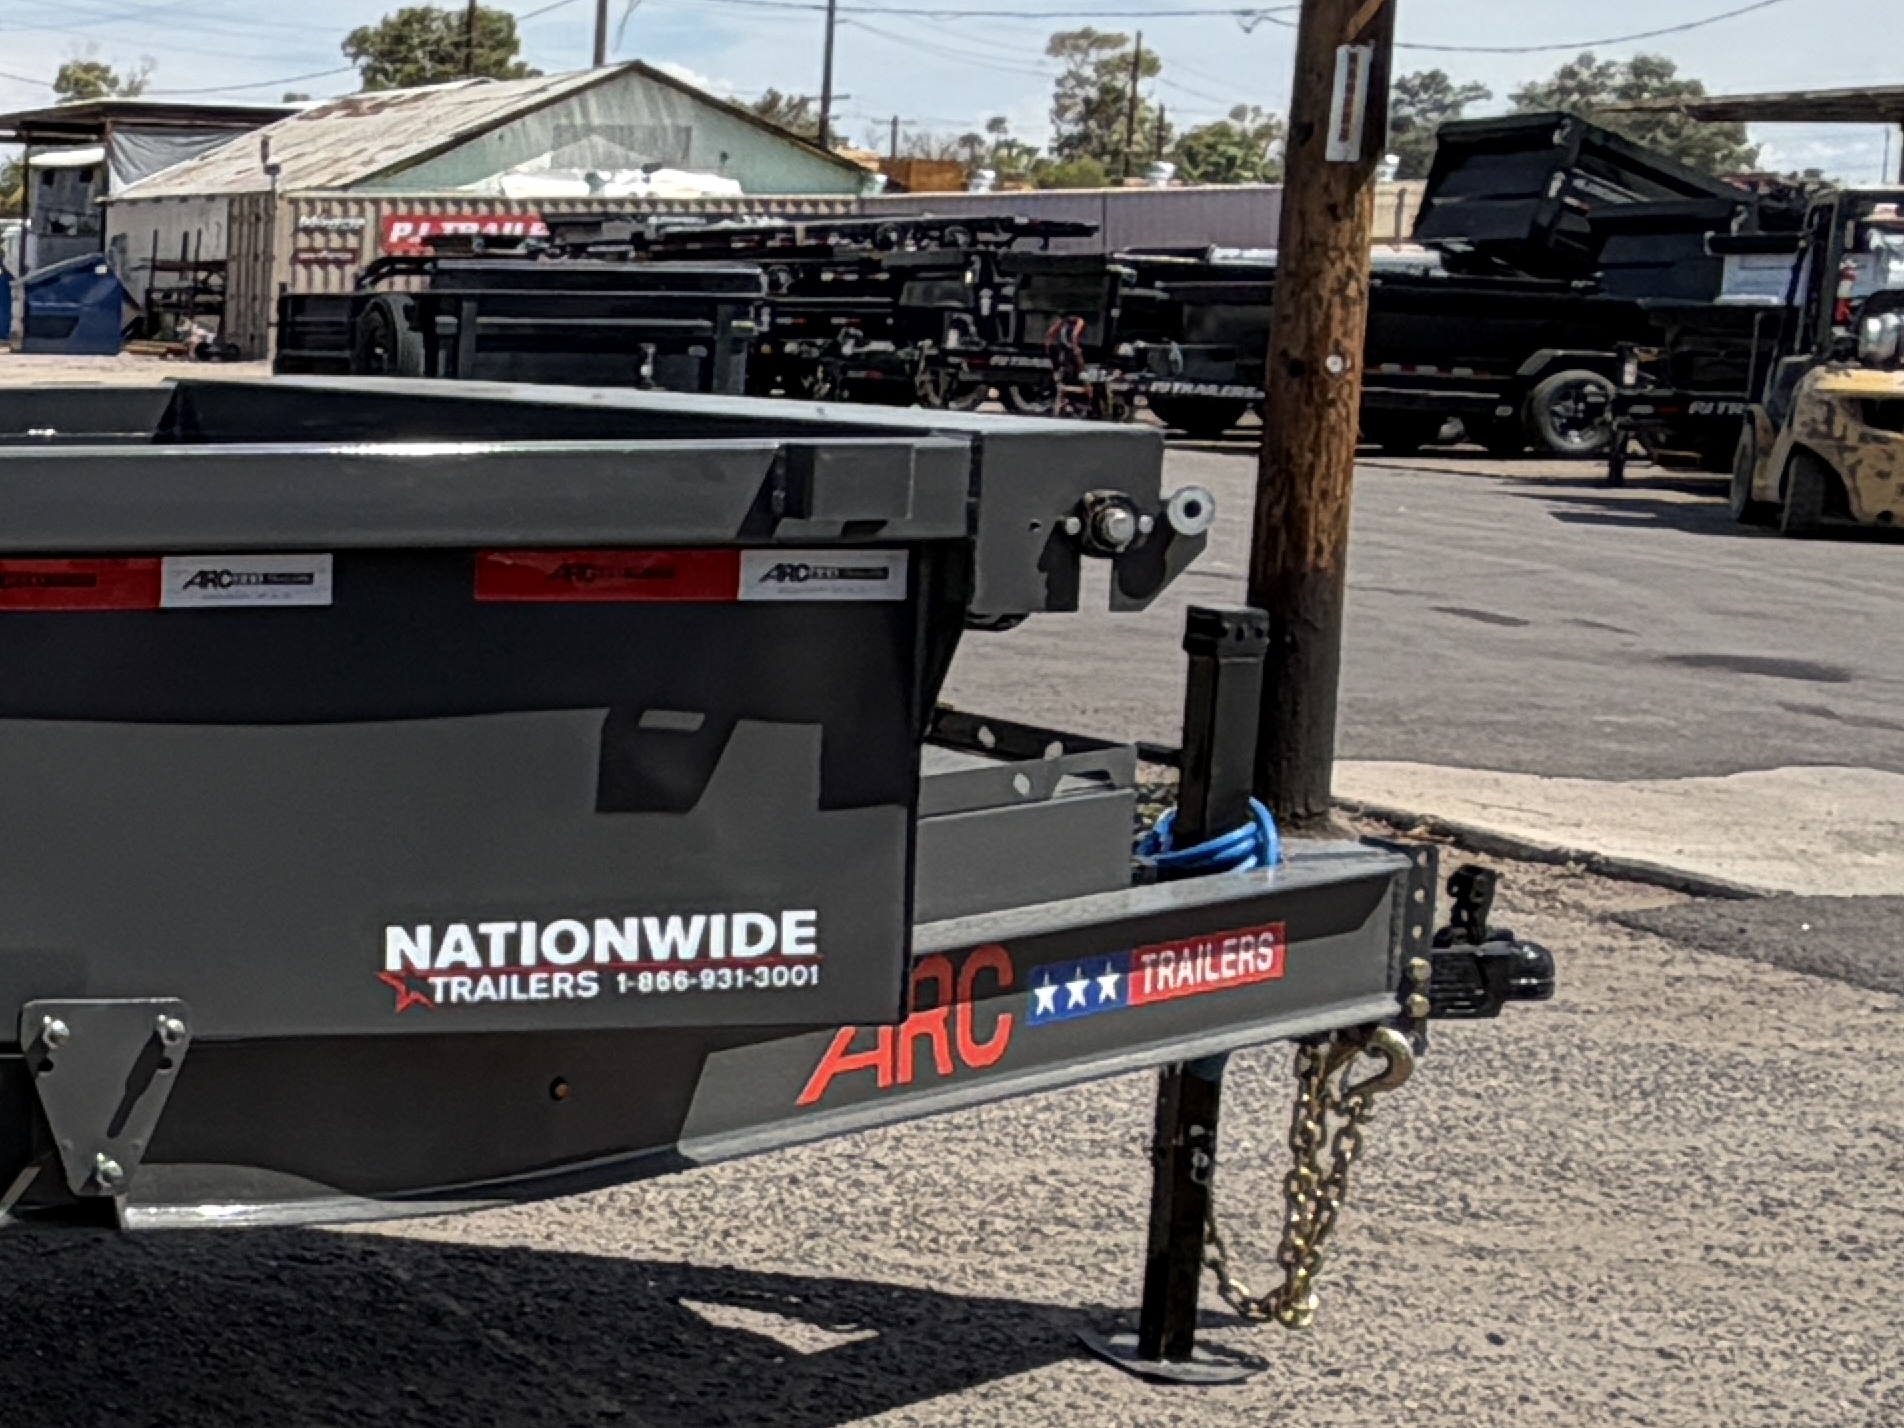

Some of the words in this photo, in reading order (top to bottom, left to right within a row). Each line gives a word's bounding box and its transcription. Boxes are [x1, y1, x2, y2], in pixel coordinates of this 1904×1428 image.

[182, 568, 233, 590] ARC
[758, 562, 810, 583] ARC
[384, 908, 819, 972] NATIONWIDE
[428, 969, 600, 1004] TRAILERS
[616, 964, 820, 995] 1-866-931-3001
[795, 943, 1015, 1106] ARC
[1140, 931, 1275, 995] TRAILERS
